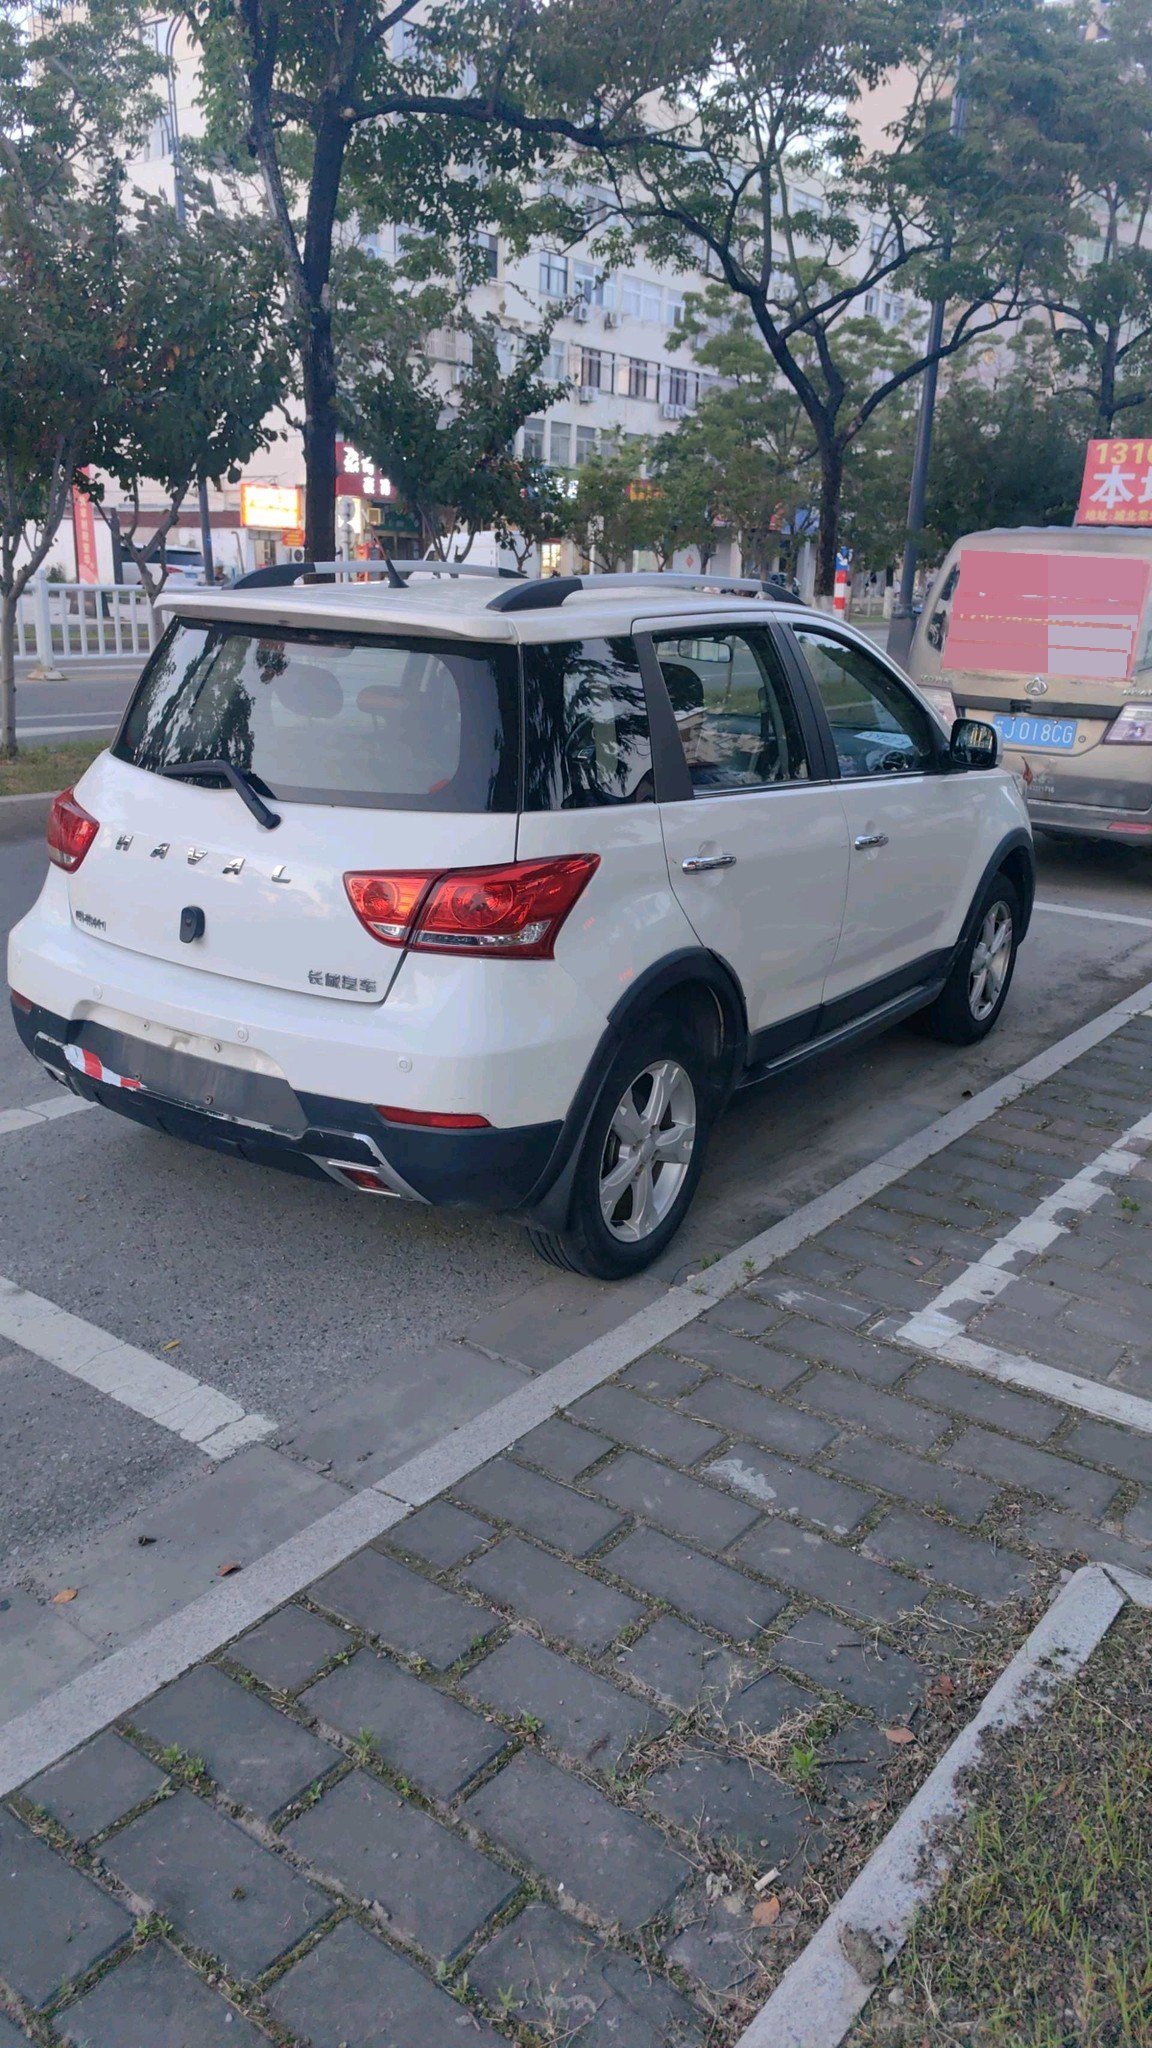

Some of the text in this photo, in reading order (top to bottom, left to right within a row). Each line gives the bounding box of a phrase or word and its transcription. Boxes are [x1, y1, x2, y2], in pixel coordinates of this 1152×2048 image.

[115, 834, 292, 884] HAVAL
[307, 969, 377, 993] 长城汽车
